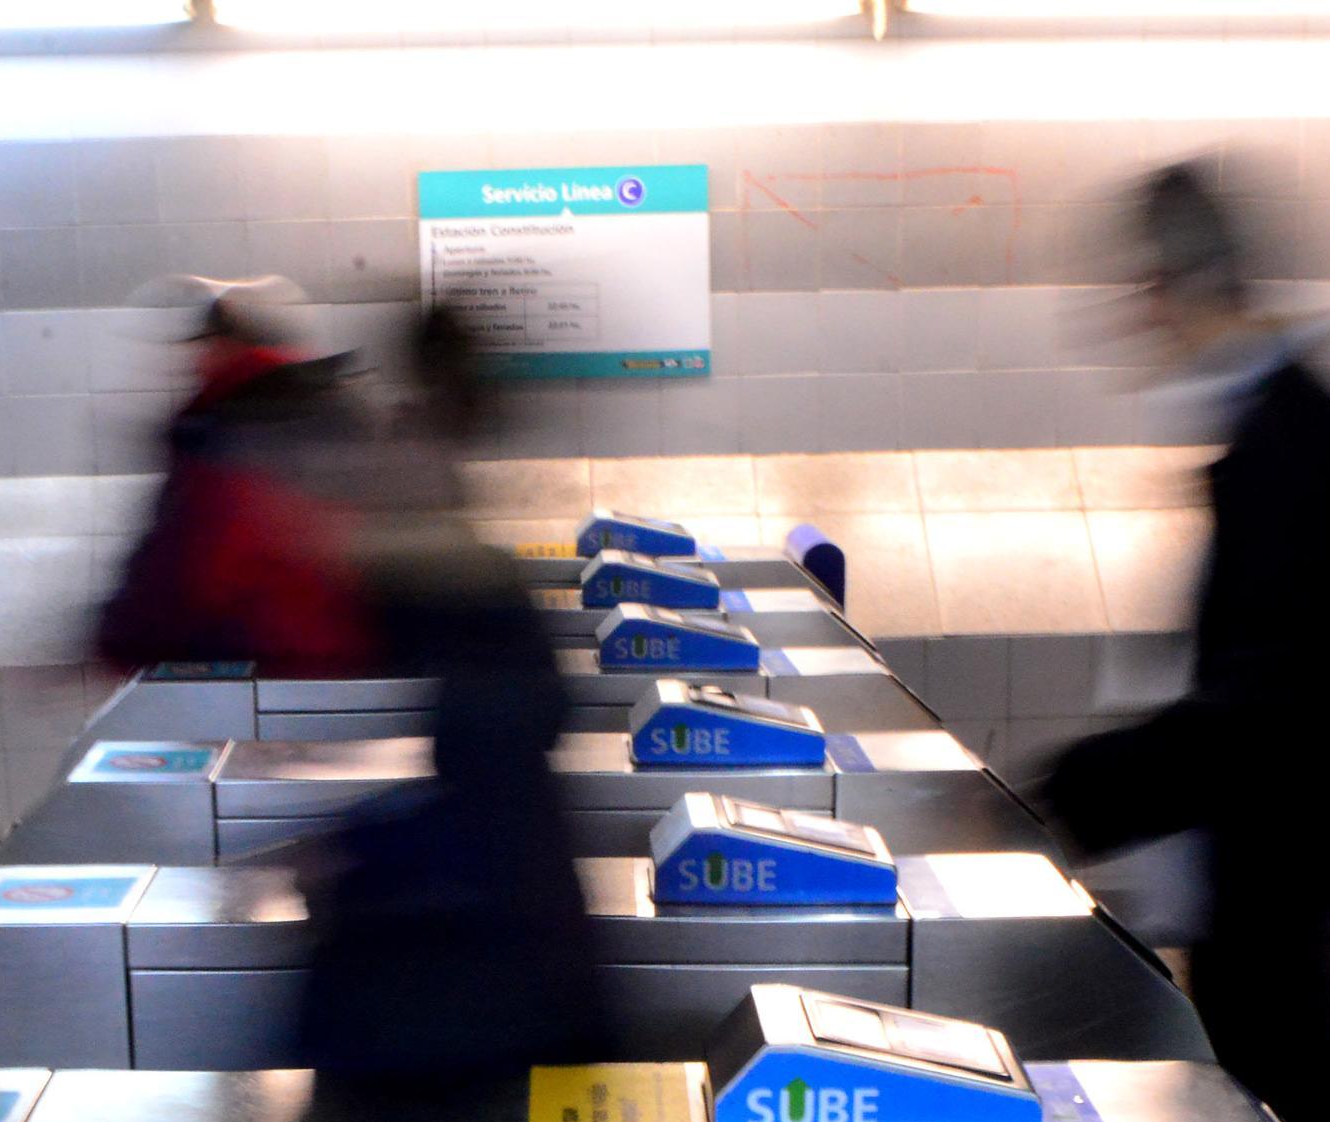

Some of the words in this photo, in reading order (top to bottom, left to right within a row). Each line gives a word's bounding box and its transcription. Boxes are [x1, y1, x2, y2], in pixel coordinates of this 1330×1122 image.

[481, 183, 557, 204] Servicio
[596, 577, 651, 599] SUBE
[614, 636, 681, 663] SUBE
[650, 727, 730, 755] SUBE
[678, 858, 777, 892] SUBE
